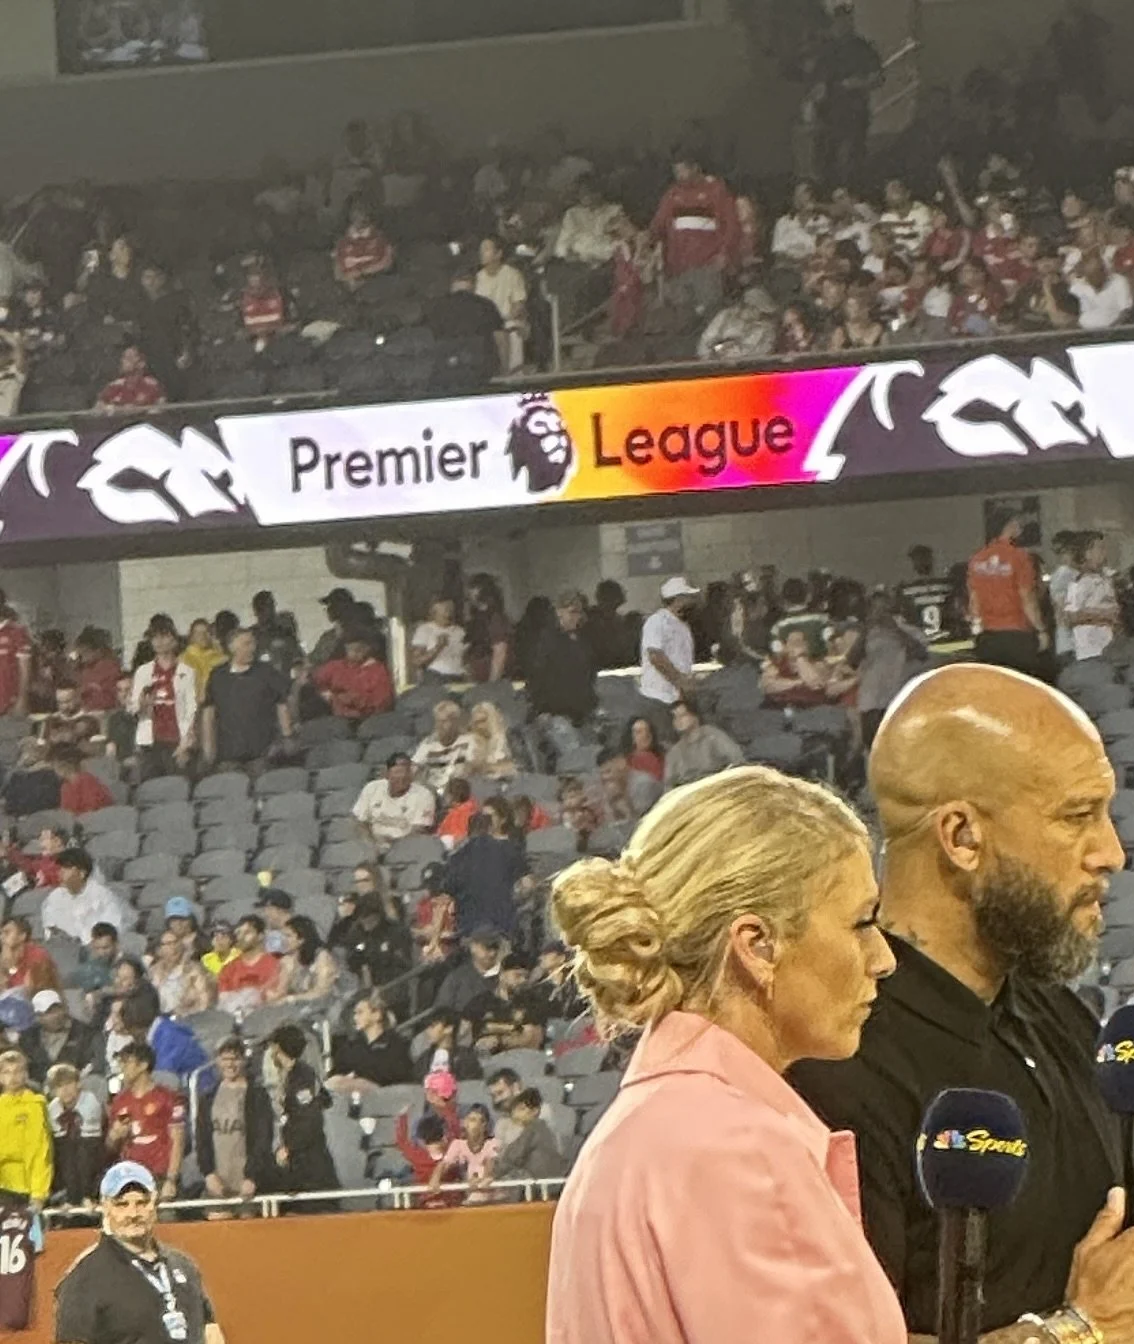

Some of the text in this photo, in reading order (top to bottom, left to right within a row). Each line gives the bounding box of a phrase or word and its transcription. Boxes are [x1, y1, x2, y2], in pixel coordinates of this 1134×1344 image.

[288, 411, 794, 493] Premier League
[965, 1129, 1028, 1158] Sports
[0, 1234, 26, 1274] 16
